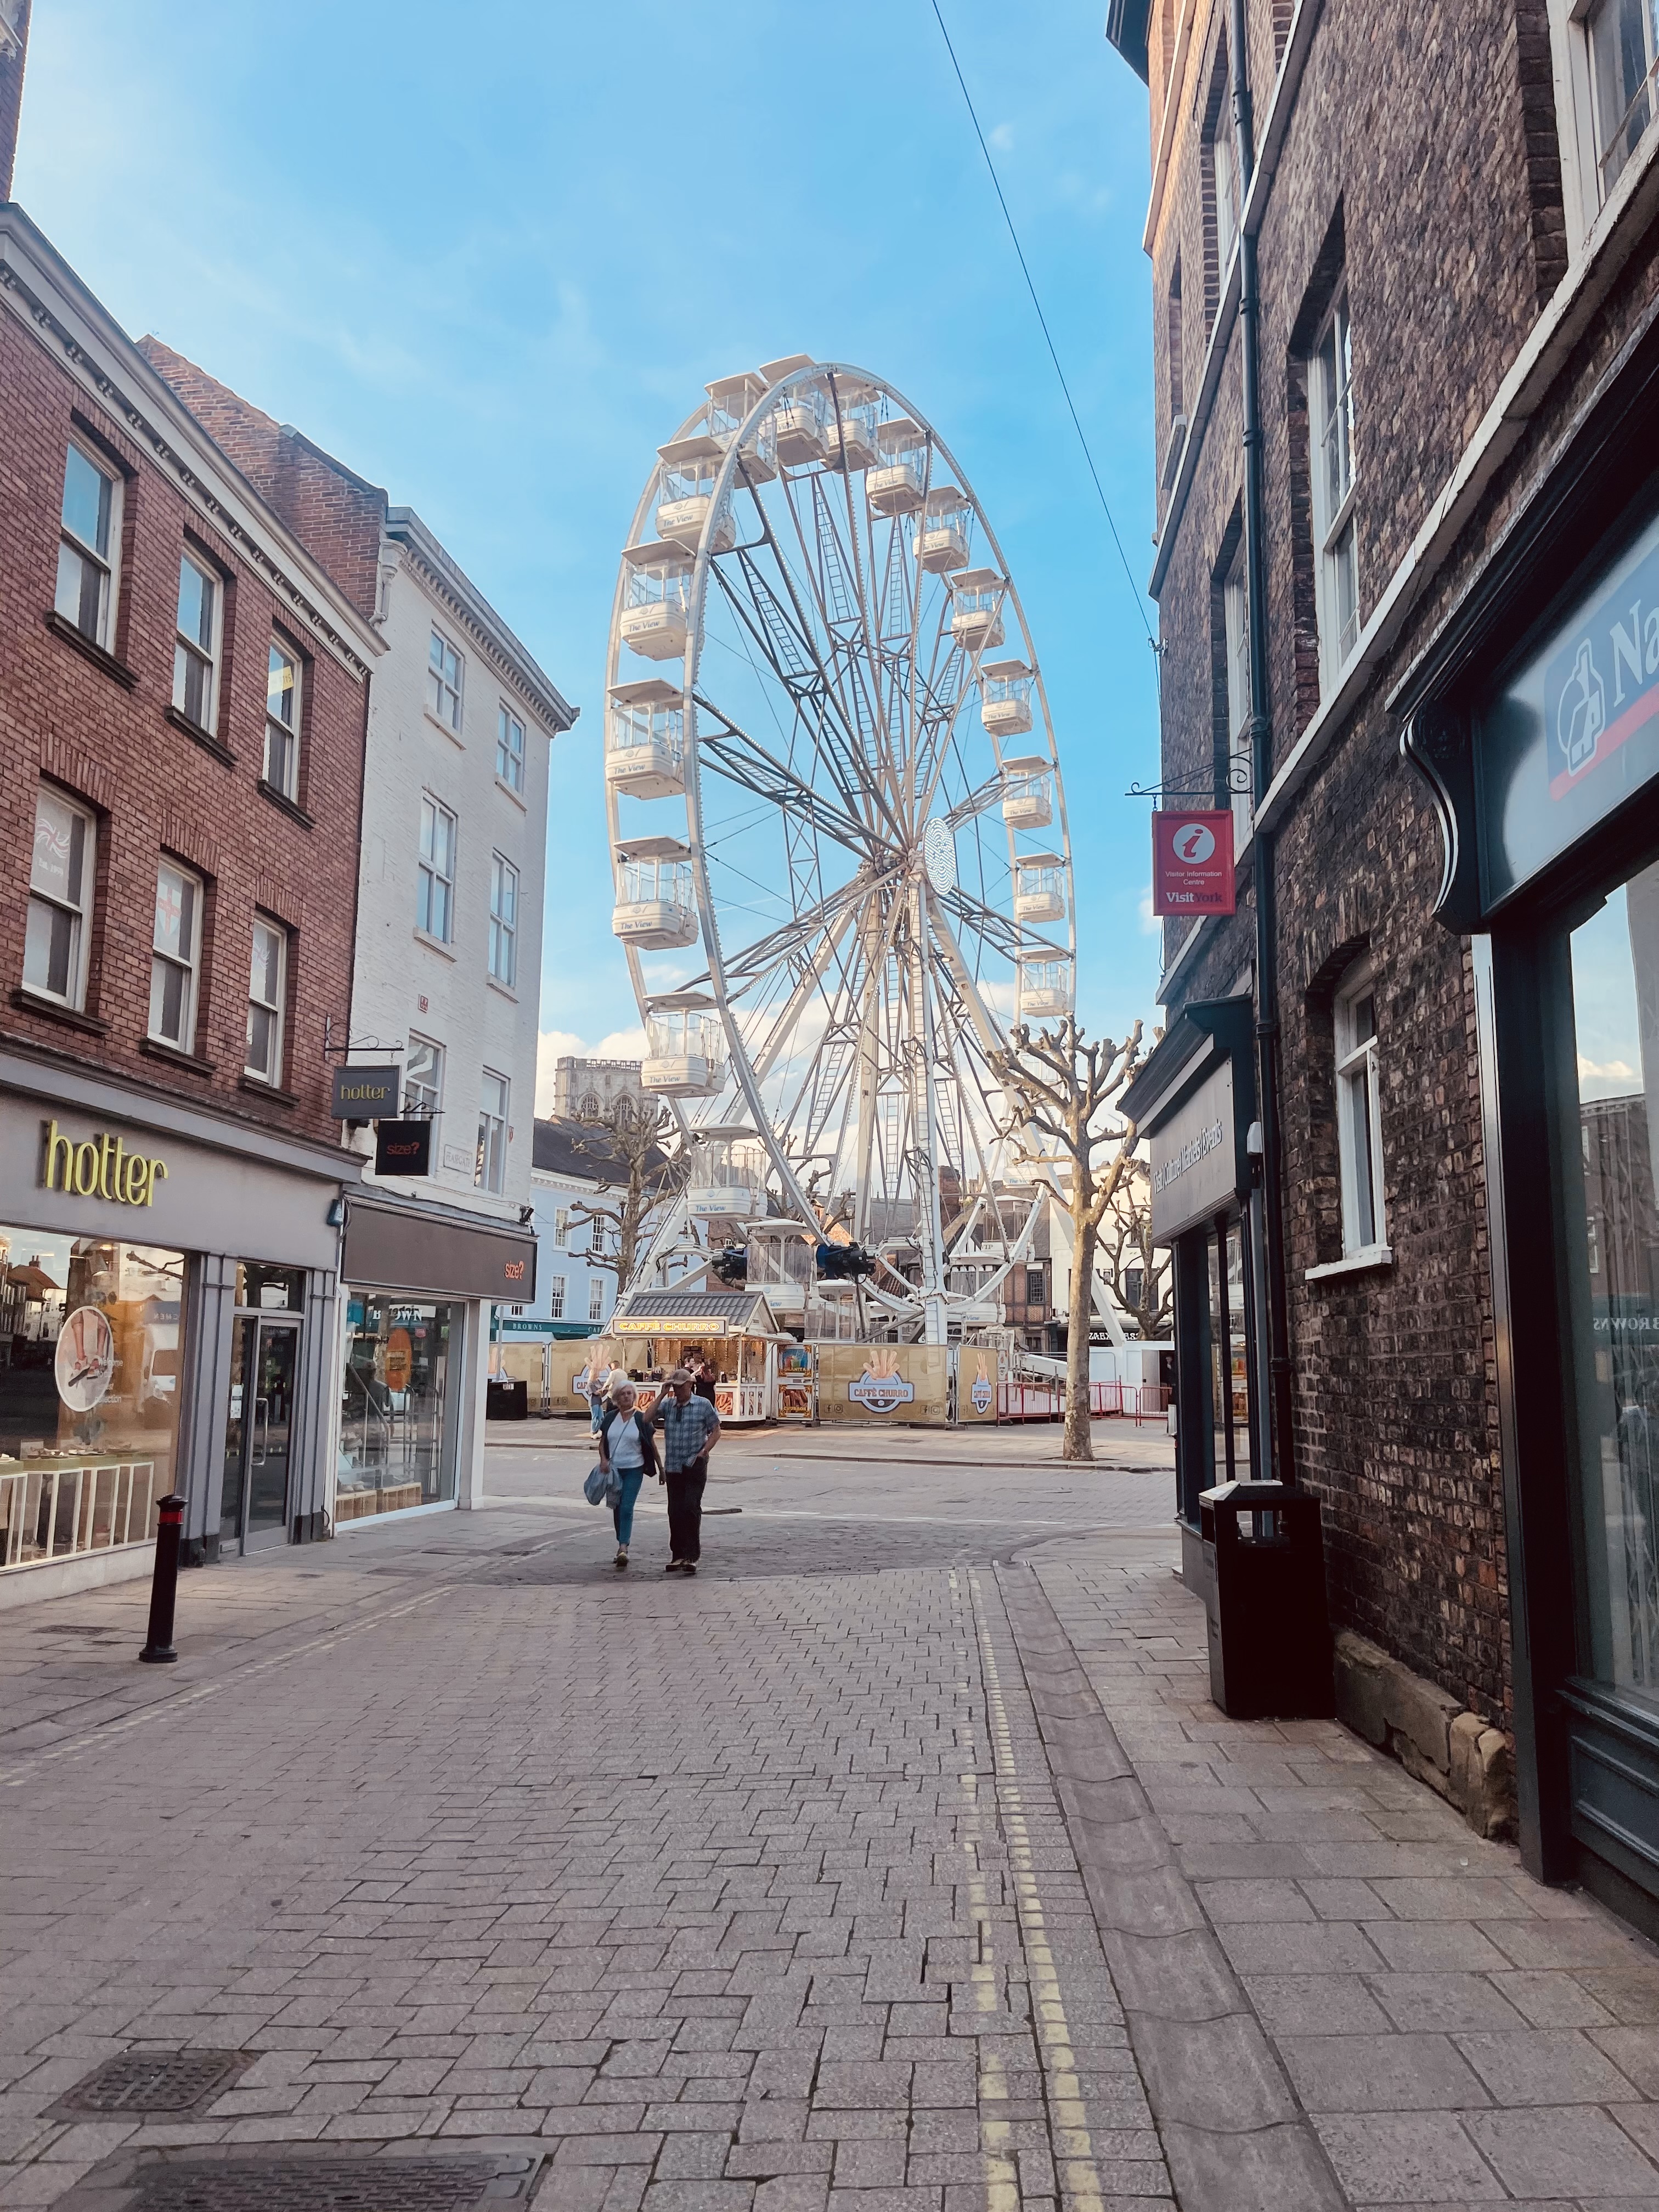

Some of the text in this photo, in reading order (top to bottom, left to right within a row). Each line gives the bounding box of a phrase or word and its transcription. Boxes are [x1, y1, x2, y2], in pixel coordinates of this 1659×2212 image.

[676, 515, 693, 523] View
[628, 764, 645, 772] View
[341, 1084, 391, 1101] hotter
[386, 1141, 420, 1155] size?
[47, 1120, 168, 1207] hotter
[504, 1260, 525, 1280] size?
[663, 1322, 720, 1331] CHURRO
[878, 1389, 909, 1398] CHURRO
